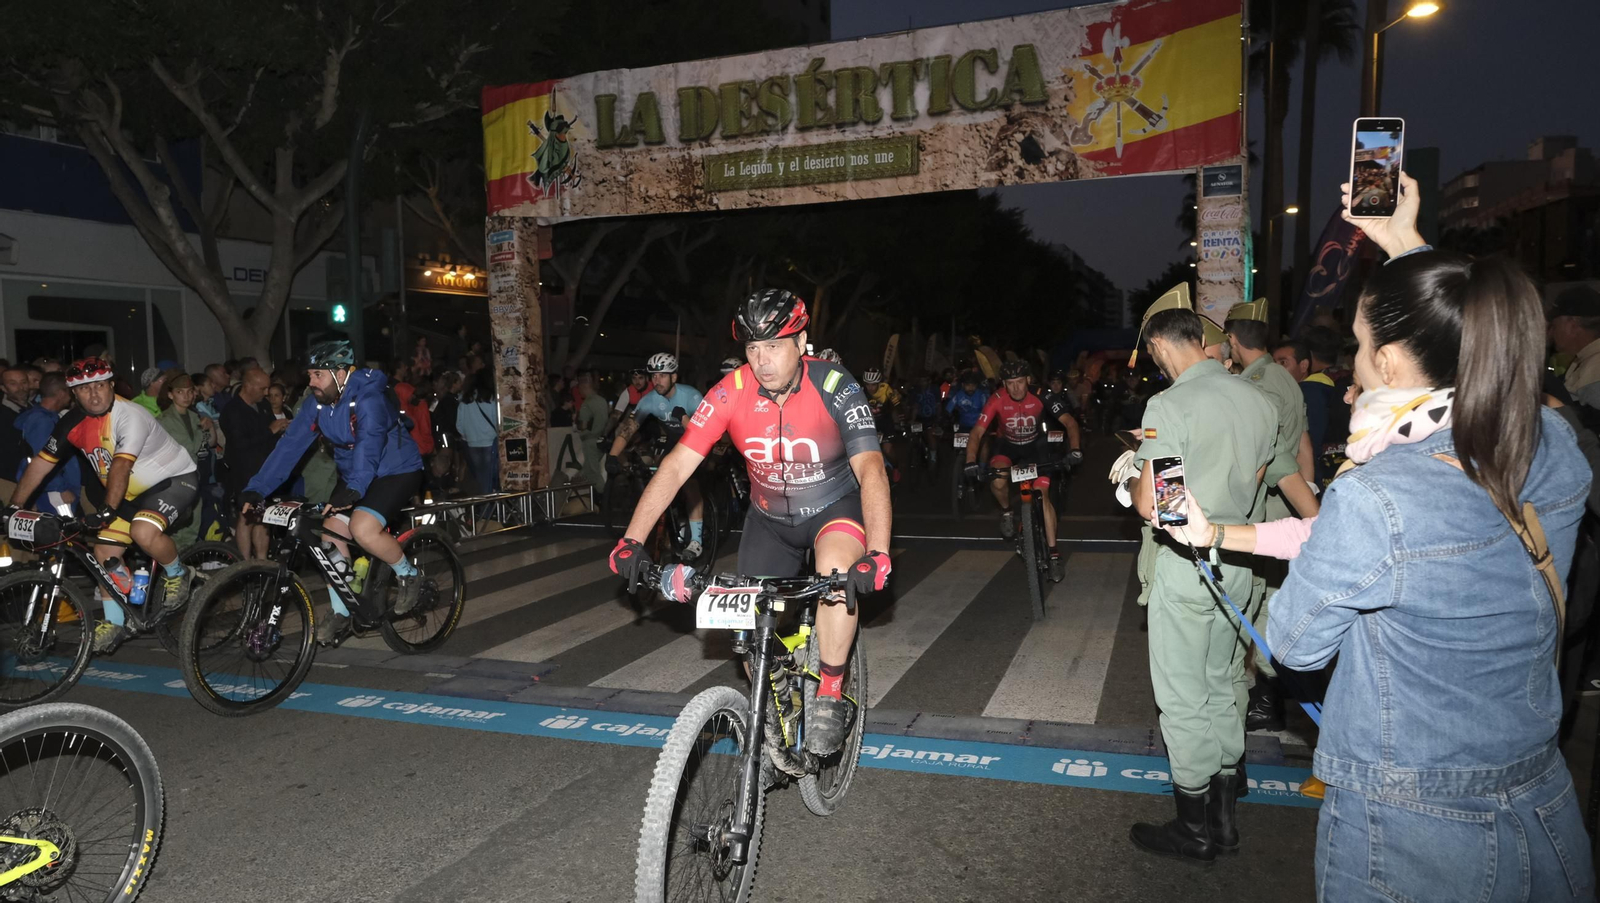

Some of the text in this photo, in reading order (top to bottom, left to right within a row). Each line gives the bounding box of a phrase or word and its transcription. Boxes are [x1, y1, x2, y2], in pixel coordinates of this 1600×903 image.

[594, 43, 1050, 149] LA DESÉRTICA
[724, 151, 894, 178] La Legión y el desierto nos une
[1203, 230, 1240, 238] GRUPO
[1203, 237, 1241, 248] RENTA
[1005, 415, 1036, 428] am
[744, 436, 821, 463] am
[14, 518, 34, 532] 7832
[308, 545, 360, 606] SCOTT
[708, 593, 752, 613] 7449
[382, 702, 507, 720] cajamar
[949, 762, 992, 771] RURAL
[124, 828, 154, 895] MAXXIS
